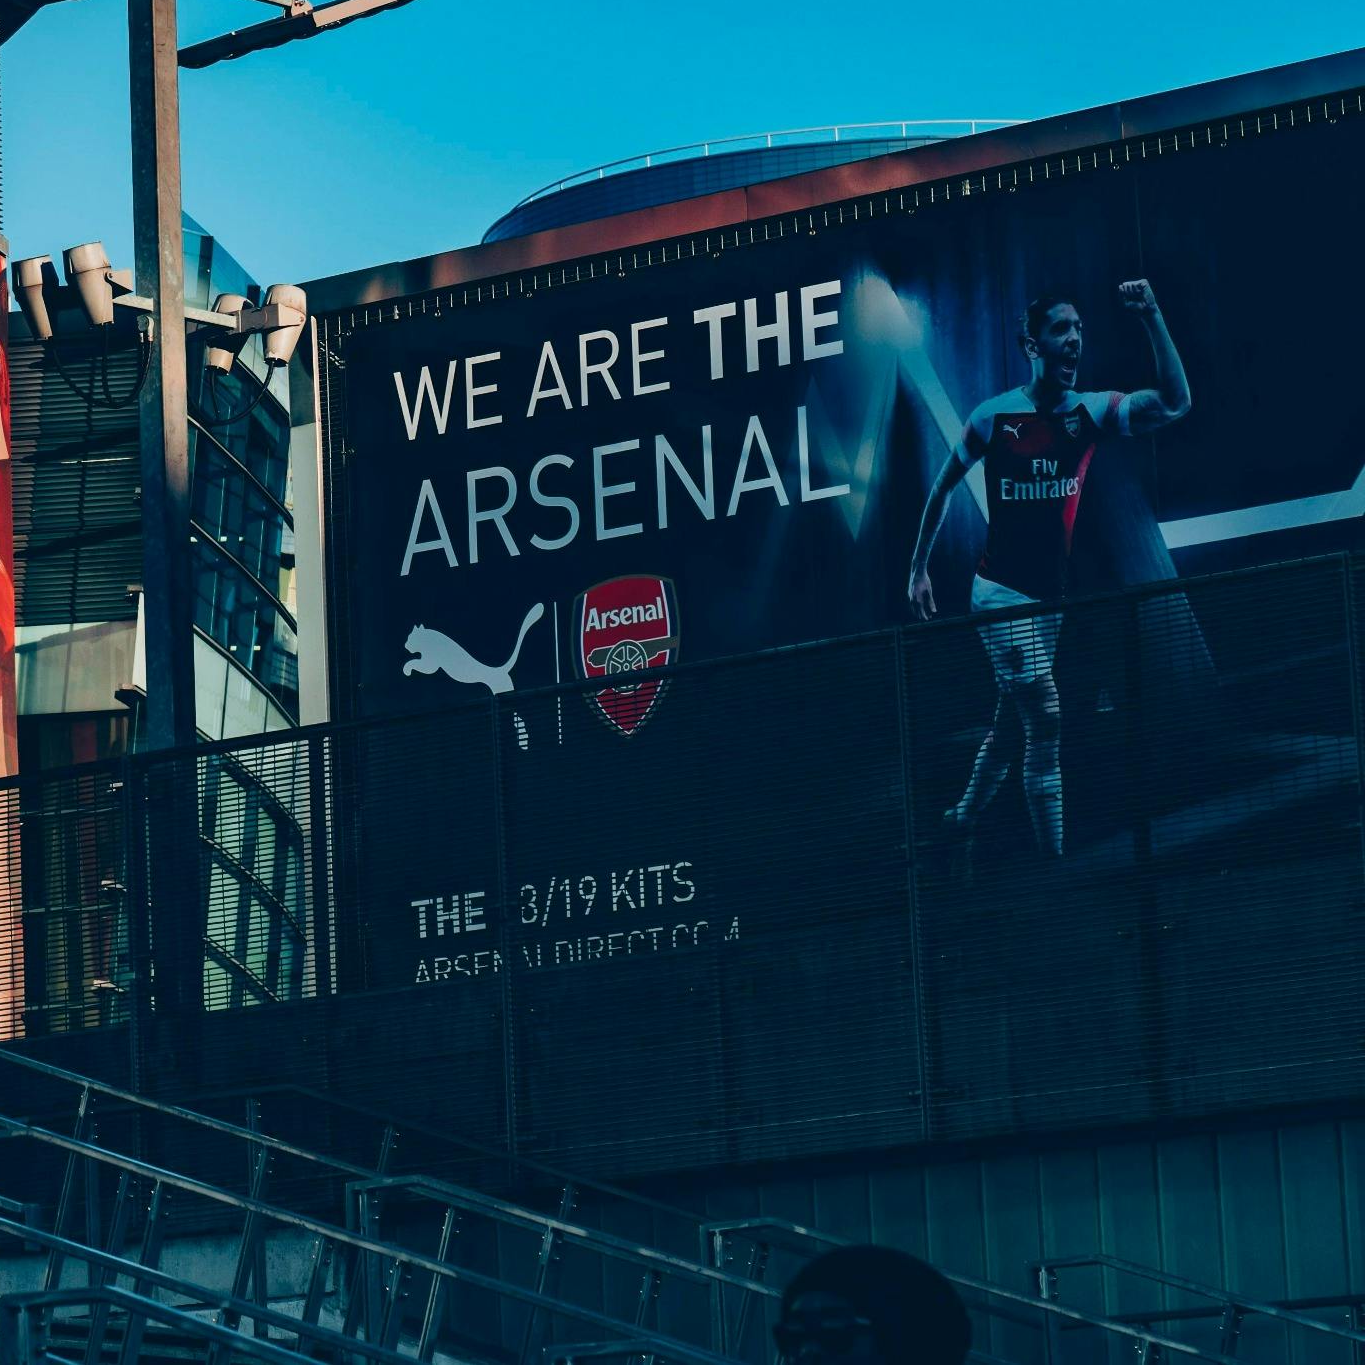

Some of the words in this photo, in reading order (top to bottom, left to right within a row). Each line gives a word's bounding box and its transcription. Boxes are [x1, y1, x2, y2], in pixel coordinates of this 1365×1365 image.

[393, 352, 503, 441] WE
[526, 316, 671, 418] ARE
[693, 279, 845, 381] THE
[400, 405, 851, 577] ARSENAL
[1000, 475, 1079, 501] Emirates
[1032, 458, 1058, 476] Fly
[585, 596, 665, 633] Arsenal
[411, 891, 486, 939] THE
[612, 861, 695, 913] KITS
